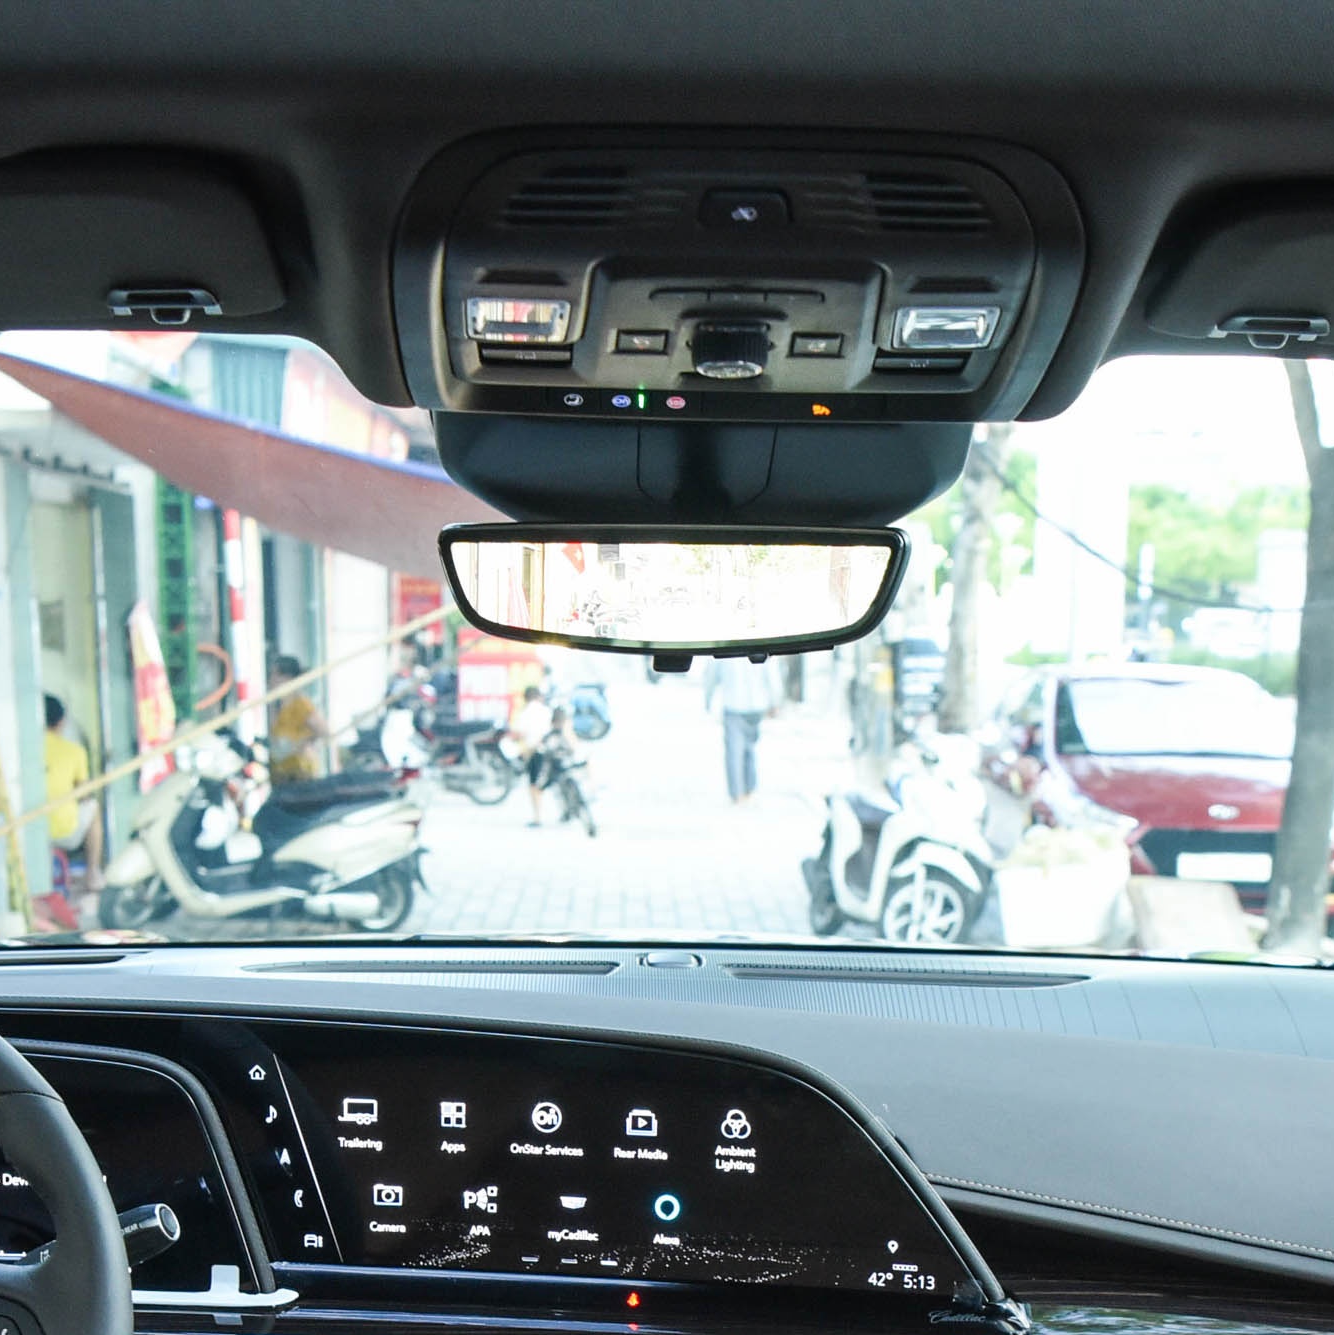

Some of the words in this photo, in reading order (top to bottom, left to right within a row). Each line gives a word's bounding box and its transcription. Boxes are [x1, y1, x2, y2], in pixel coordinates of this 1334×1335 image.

[337, 1136, 383, 1152] Trailering
[440, 1140, 466, 1154] Apps
[510, 1143, 543, 1156] OnStar
[545, 1144, 584, 1157] Services
[613, 1147, 636, 1159] Rear
[637, 1148, 669, 1160] Media
[715, 1145, 757, 1158] Ambient
[715, 1159, 755, 1174] Lighting
[369, 1221, 406, 1233] Camera
[469, 1225, 491, 1237] APA
[547, 1229, 599, 1243] myCadillac
[653, 1234, 681, 1246] Alexa
[868, 1272, 894, 1287] 42°
[903, 1275, 936, 1291] 5:13
